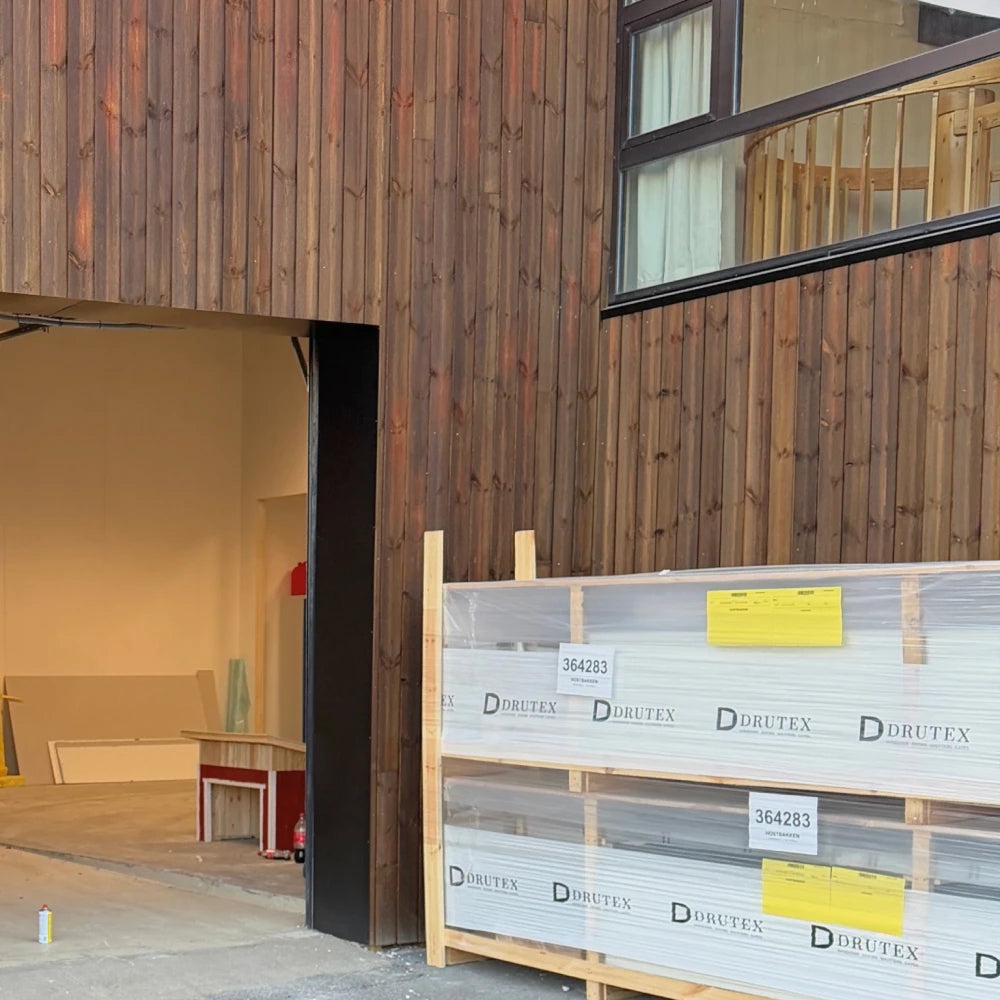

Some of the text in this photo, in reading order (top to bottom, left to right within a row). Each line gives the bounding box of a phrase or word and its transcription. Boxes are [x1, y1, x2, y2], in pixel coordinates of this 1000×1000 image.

[563, 657, 608, 674] 364283
[502, 698, 557, 714] DRUTEX
[612, 707, 676, 723] DRUTEX
[740, 713, 812, 732] DRUTEX
[887, 723, 971, 743] DRUTEX
[755, 808, 811, 828] 364283
[466, 871, 518, 891] DRUTEX
[572, 889, 632, 910] DRUTEX
[694, 910, 764, 933] DRUTEX
[838, 934, 919, 961] DRUTEX
